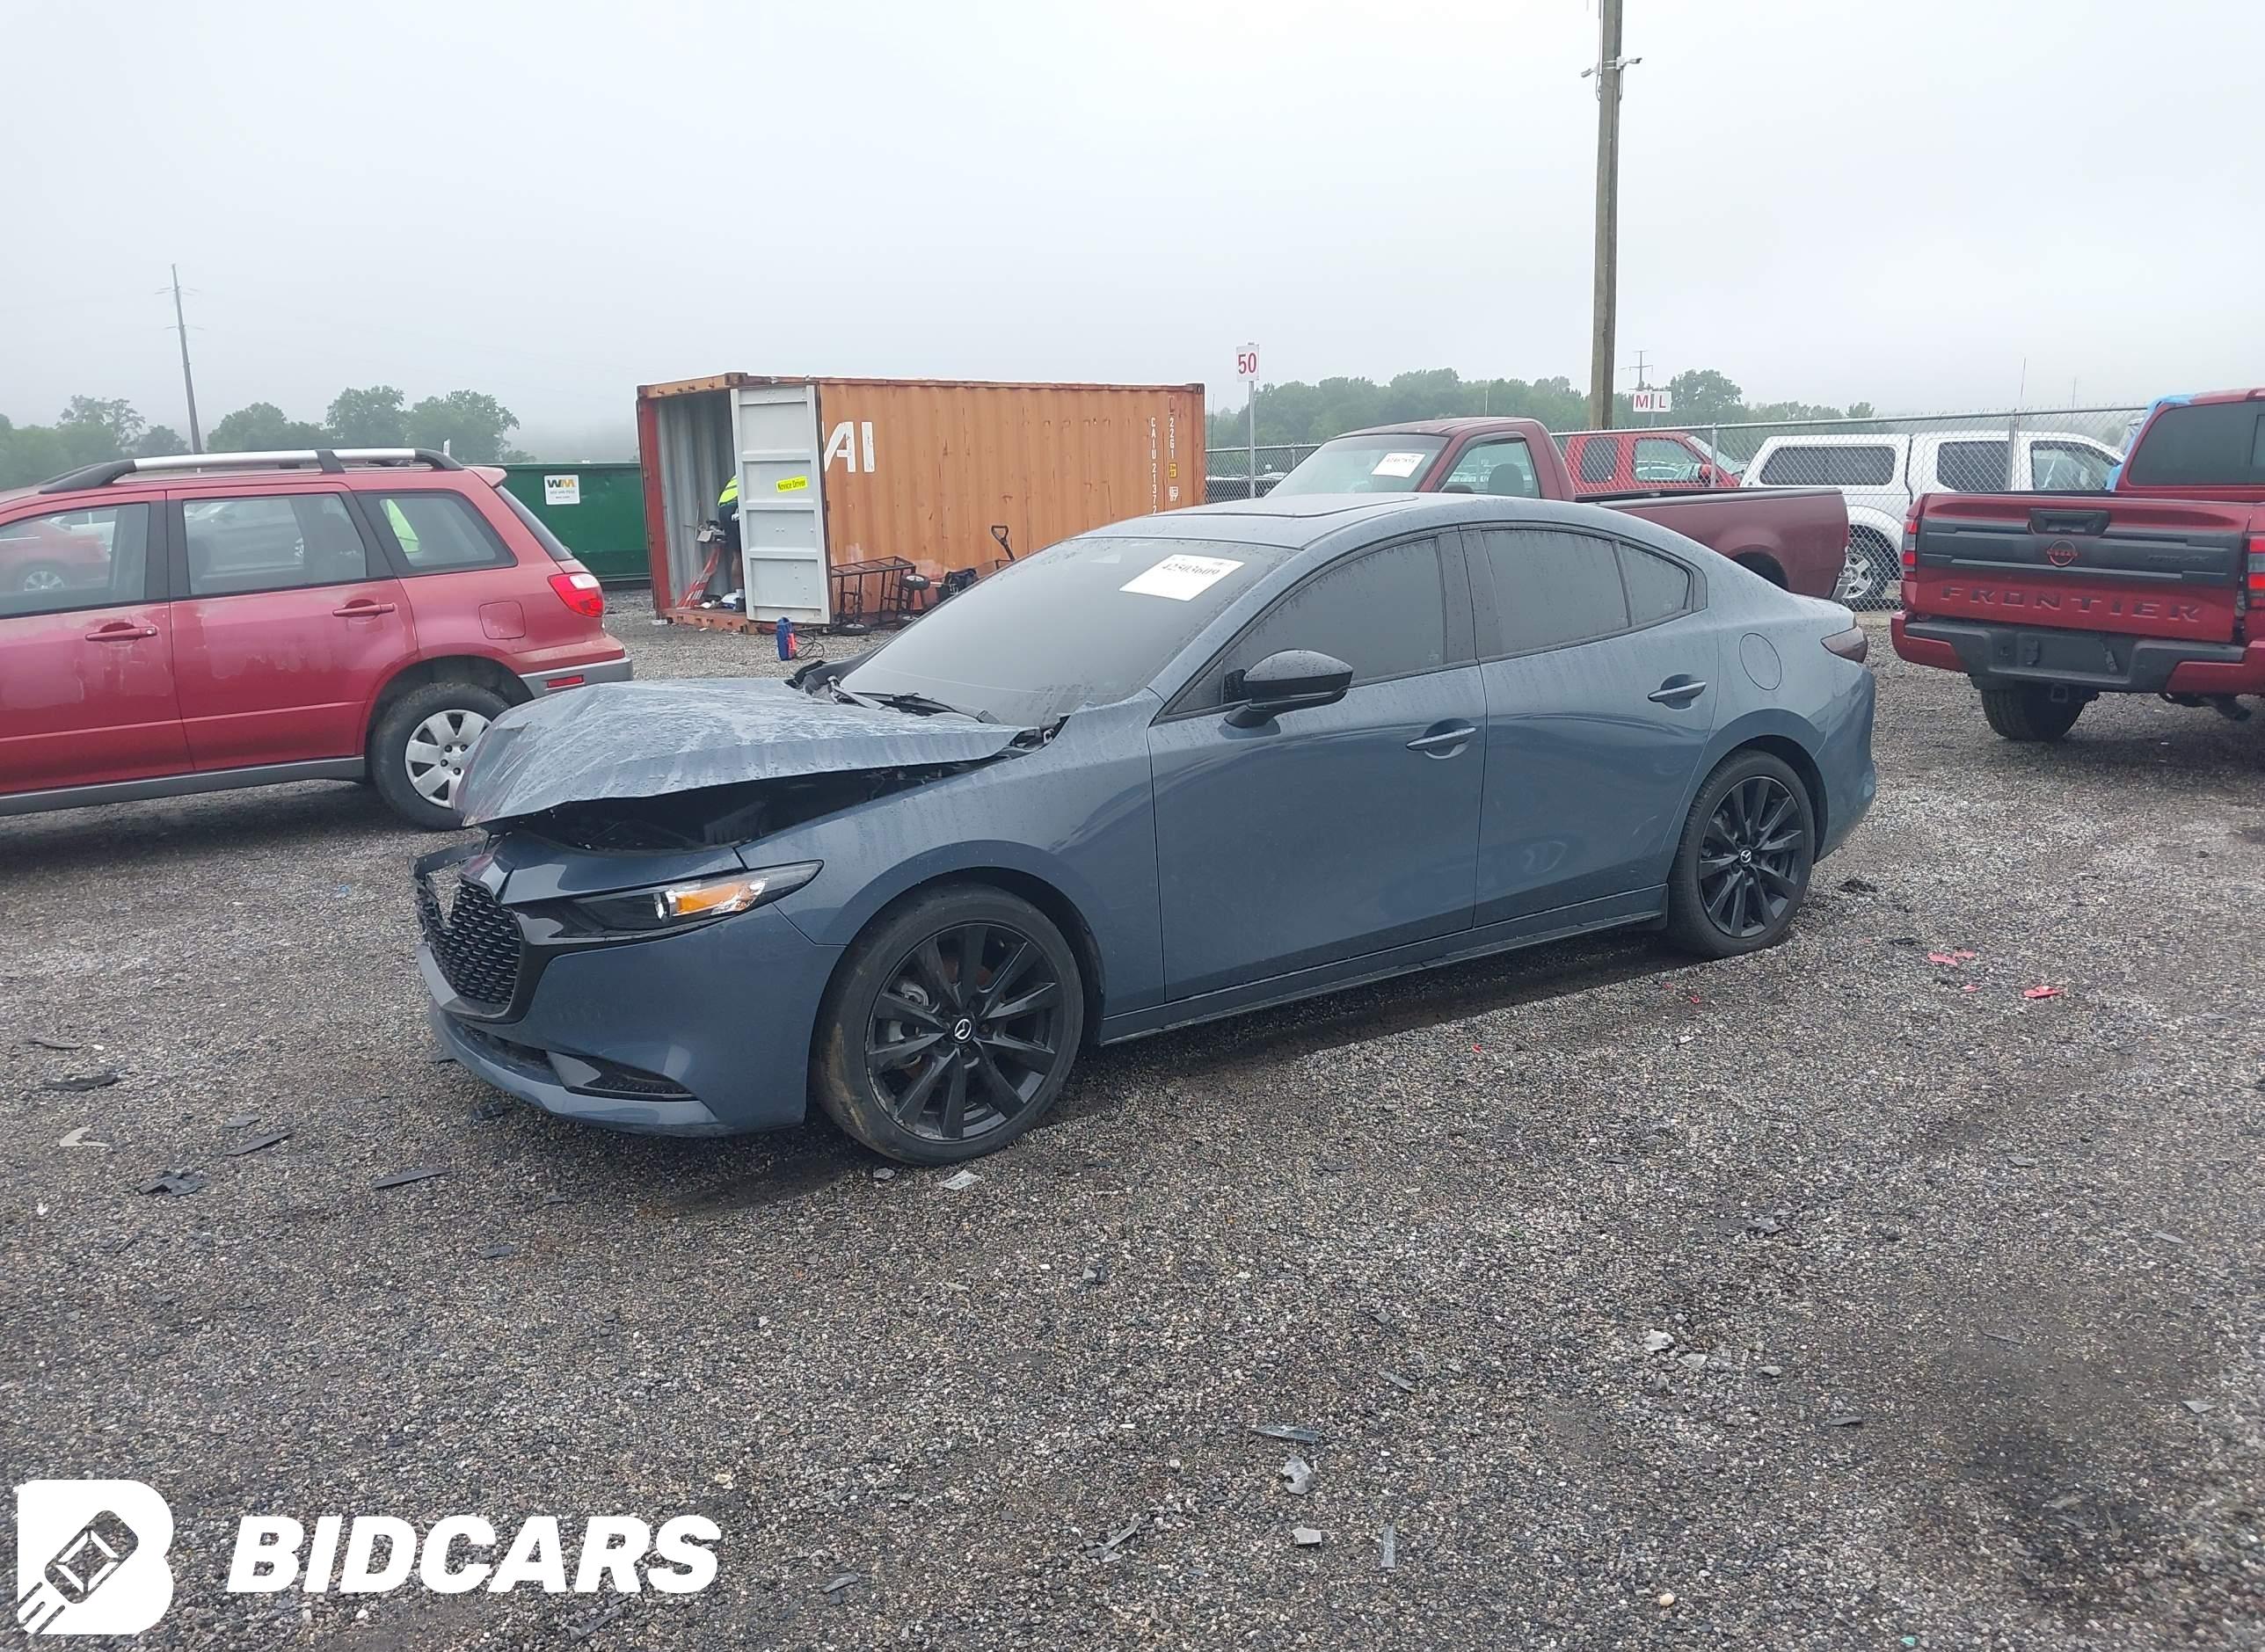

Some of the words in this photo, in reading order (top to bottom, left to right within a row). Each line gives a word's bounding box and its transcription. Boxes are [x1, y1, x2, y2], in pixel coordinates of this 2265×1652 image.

[1238, 353, 1257, 375] 50
[1635, 395, 1649, 409] M
[1658, 395, 1666, 409] L
[822, 421, 876, 473] AI
[547, 478, 576, 489] WM
[1940, 586, 2201, 622] FRONTIER
